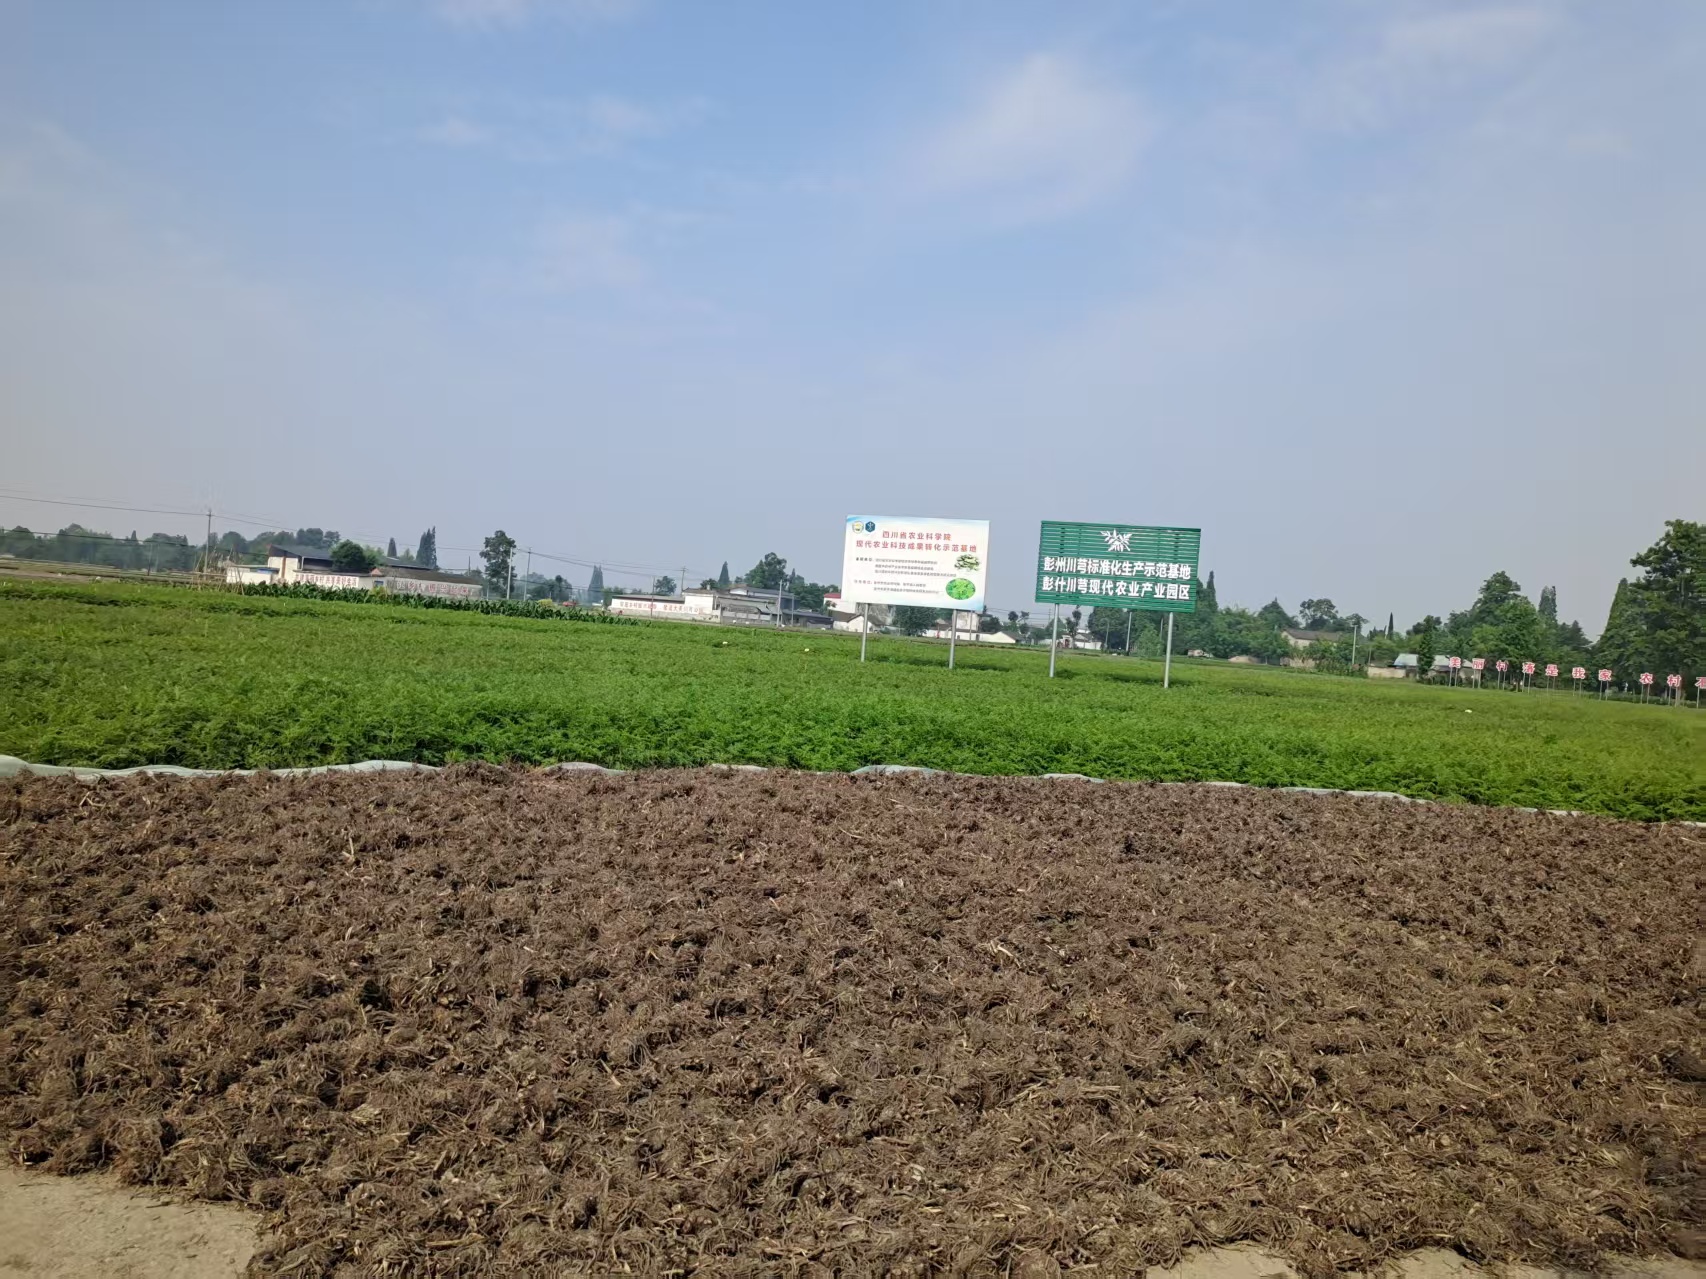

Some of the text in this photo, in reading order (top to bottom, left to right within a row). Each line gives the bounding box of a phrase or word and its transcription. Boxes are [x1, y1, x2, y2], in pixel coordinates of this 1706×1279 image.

[882, 531, 952, 541] 四川省农业科学院
[855, 540, 978, 553] 现代农业科技成果转化示范基地
[1043, 556, 1191, 580] 彭州川芎标准化生产示范基地
[1041, 576, 1191, 600] 彭什川芎现代农业产业园区
